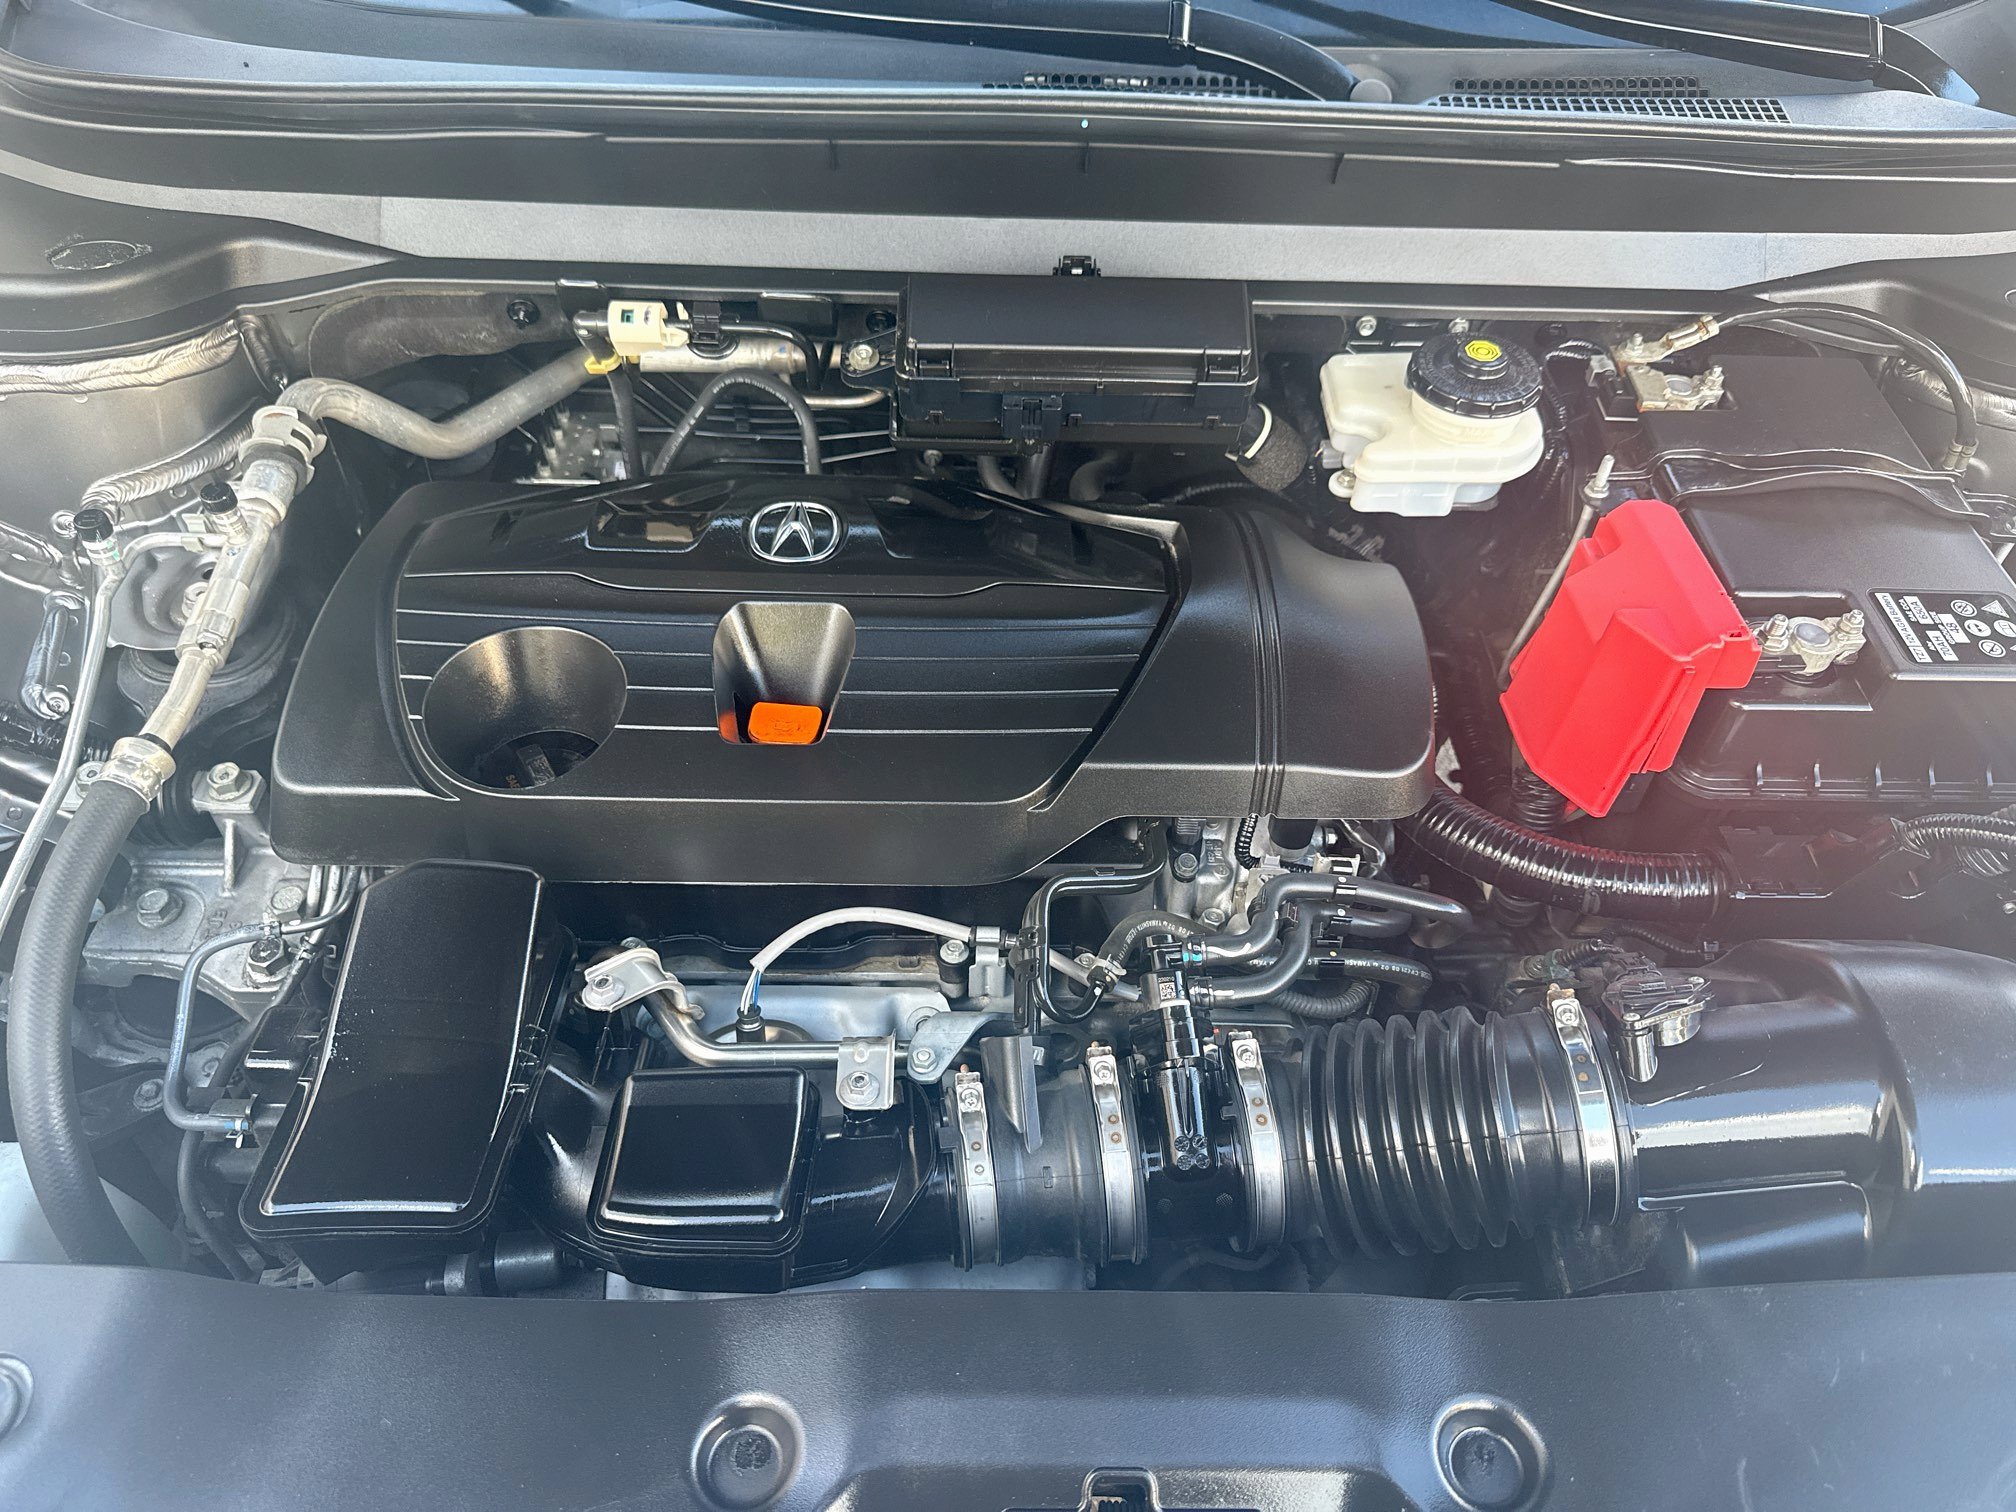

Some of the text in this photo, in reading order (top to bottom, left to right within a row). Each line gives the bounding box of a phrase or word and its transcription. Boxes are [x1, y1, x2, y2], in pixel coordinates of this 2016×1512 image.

[1881, 595, 1898, 616] Battery
[1910, 601, 1928, 620] 650A
[1945, 622, 1960, 634] 48
[1931, 635, 1953, 657] 70AH
